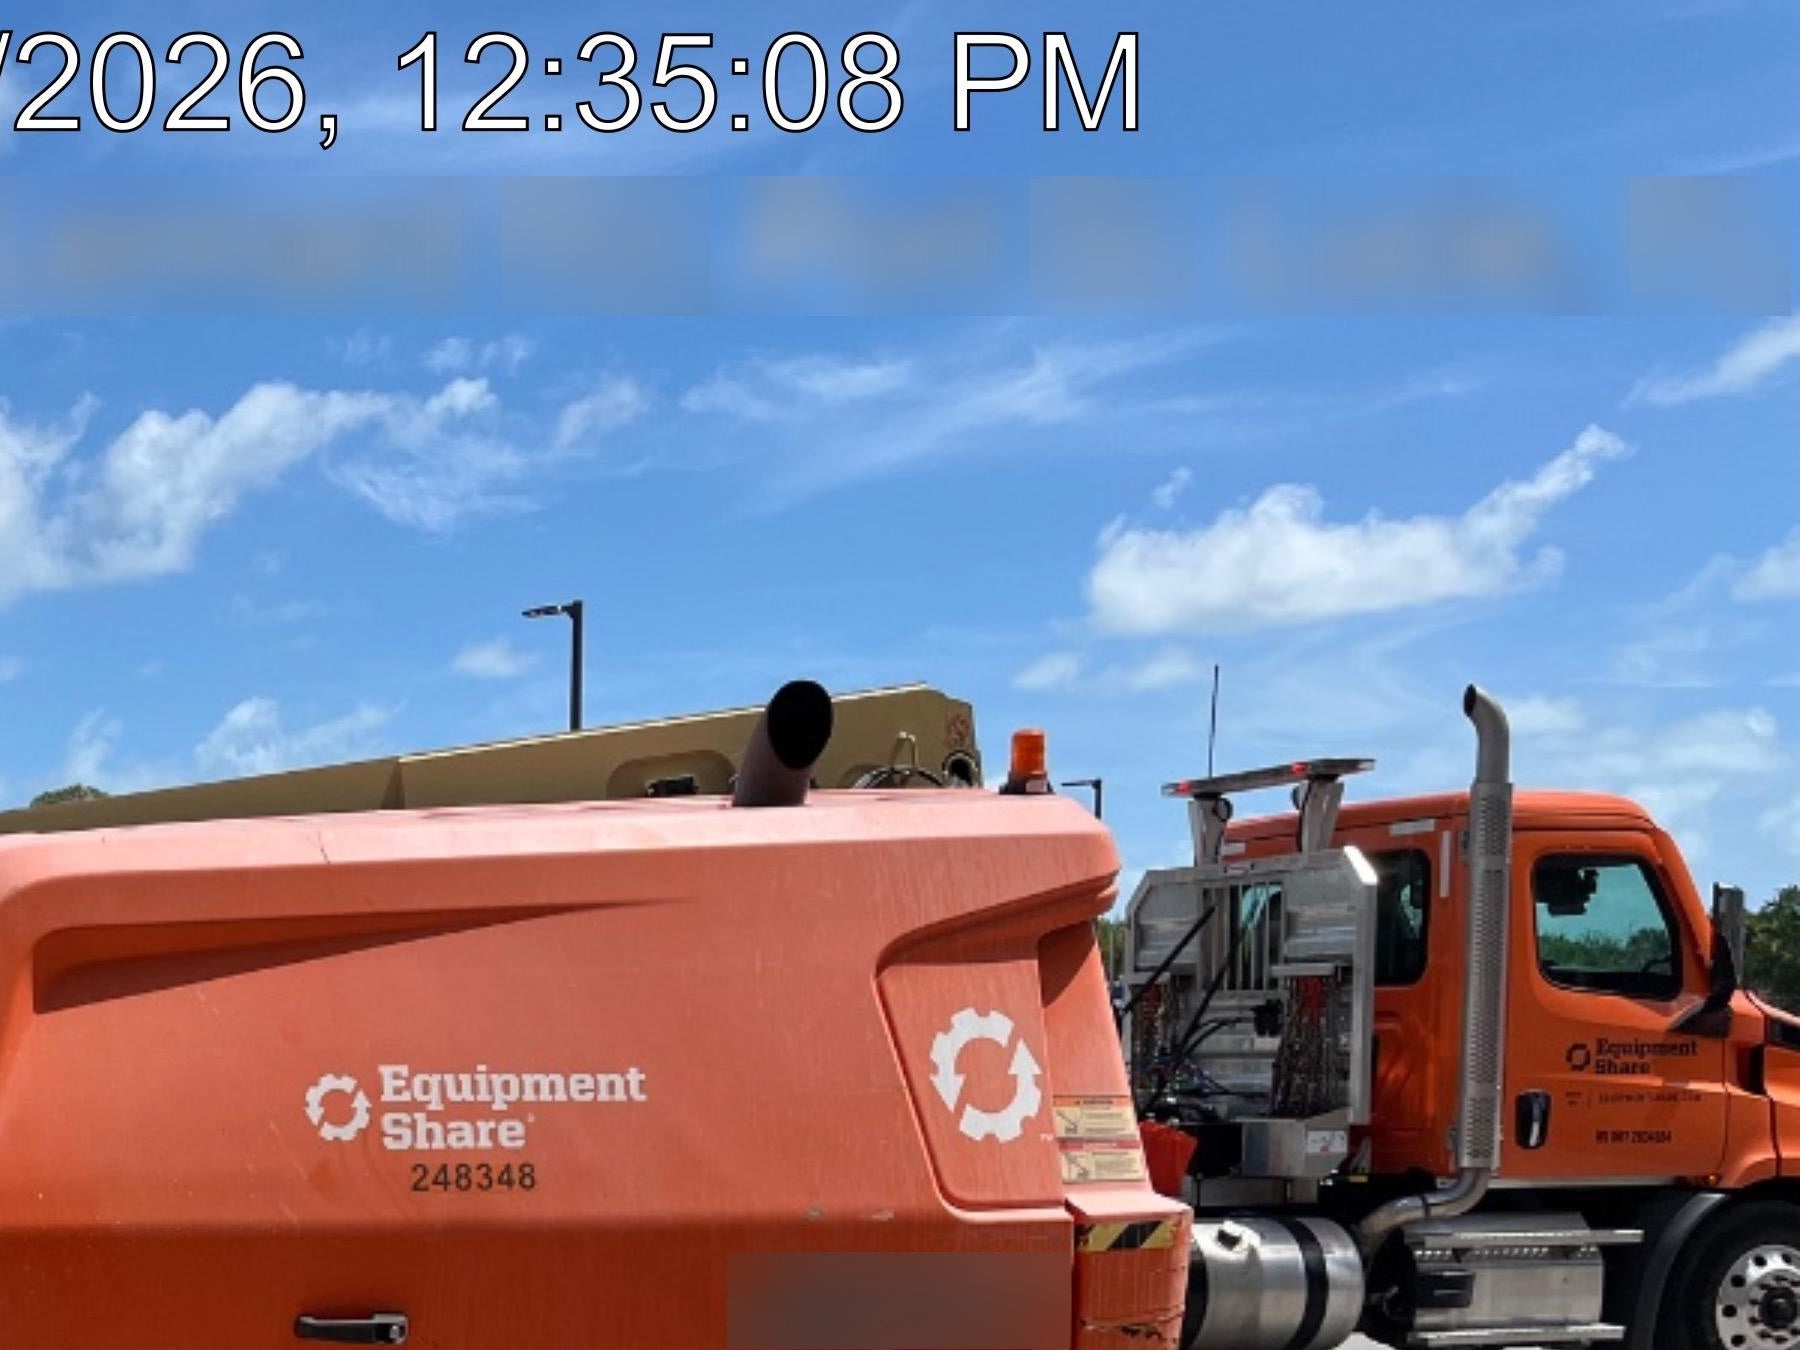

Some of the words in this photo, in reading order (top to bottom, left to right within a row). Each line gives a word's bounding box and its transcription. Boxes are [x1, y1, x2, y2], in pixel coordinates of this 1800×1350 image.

[1595, 1038, 1698, 1058] Equipment
[1595, 1059, 1650, 1075] Share
[379, 1065, 646, 1110] Equipment
[382, 1113, 525, 1150] Share
[411, 1163, 536, 1192] 248348
